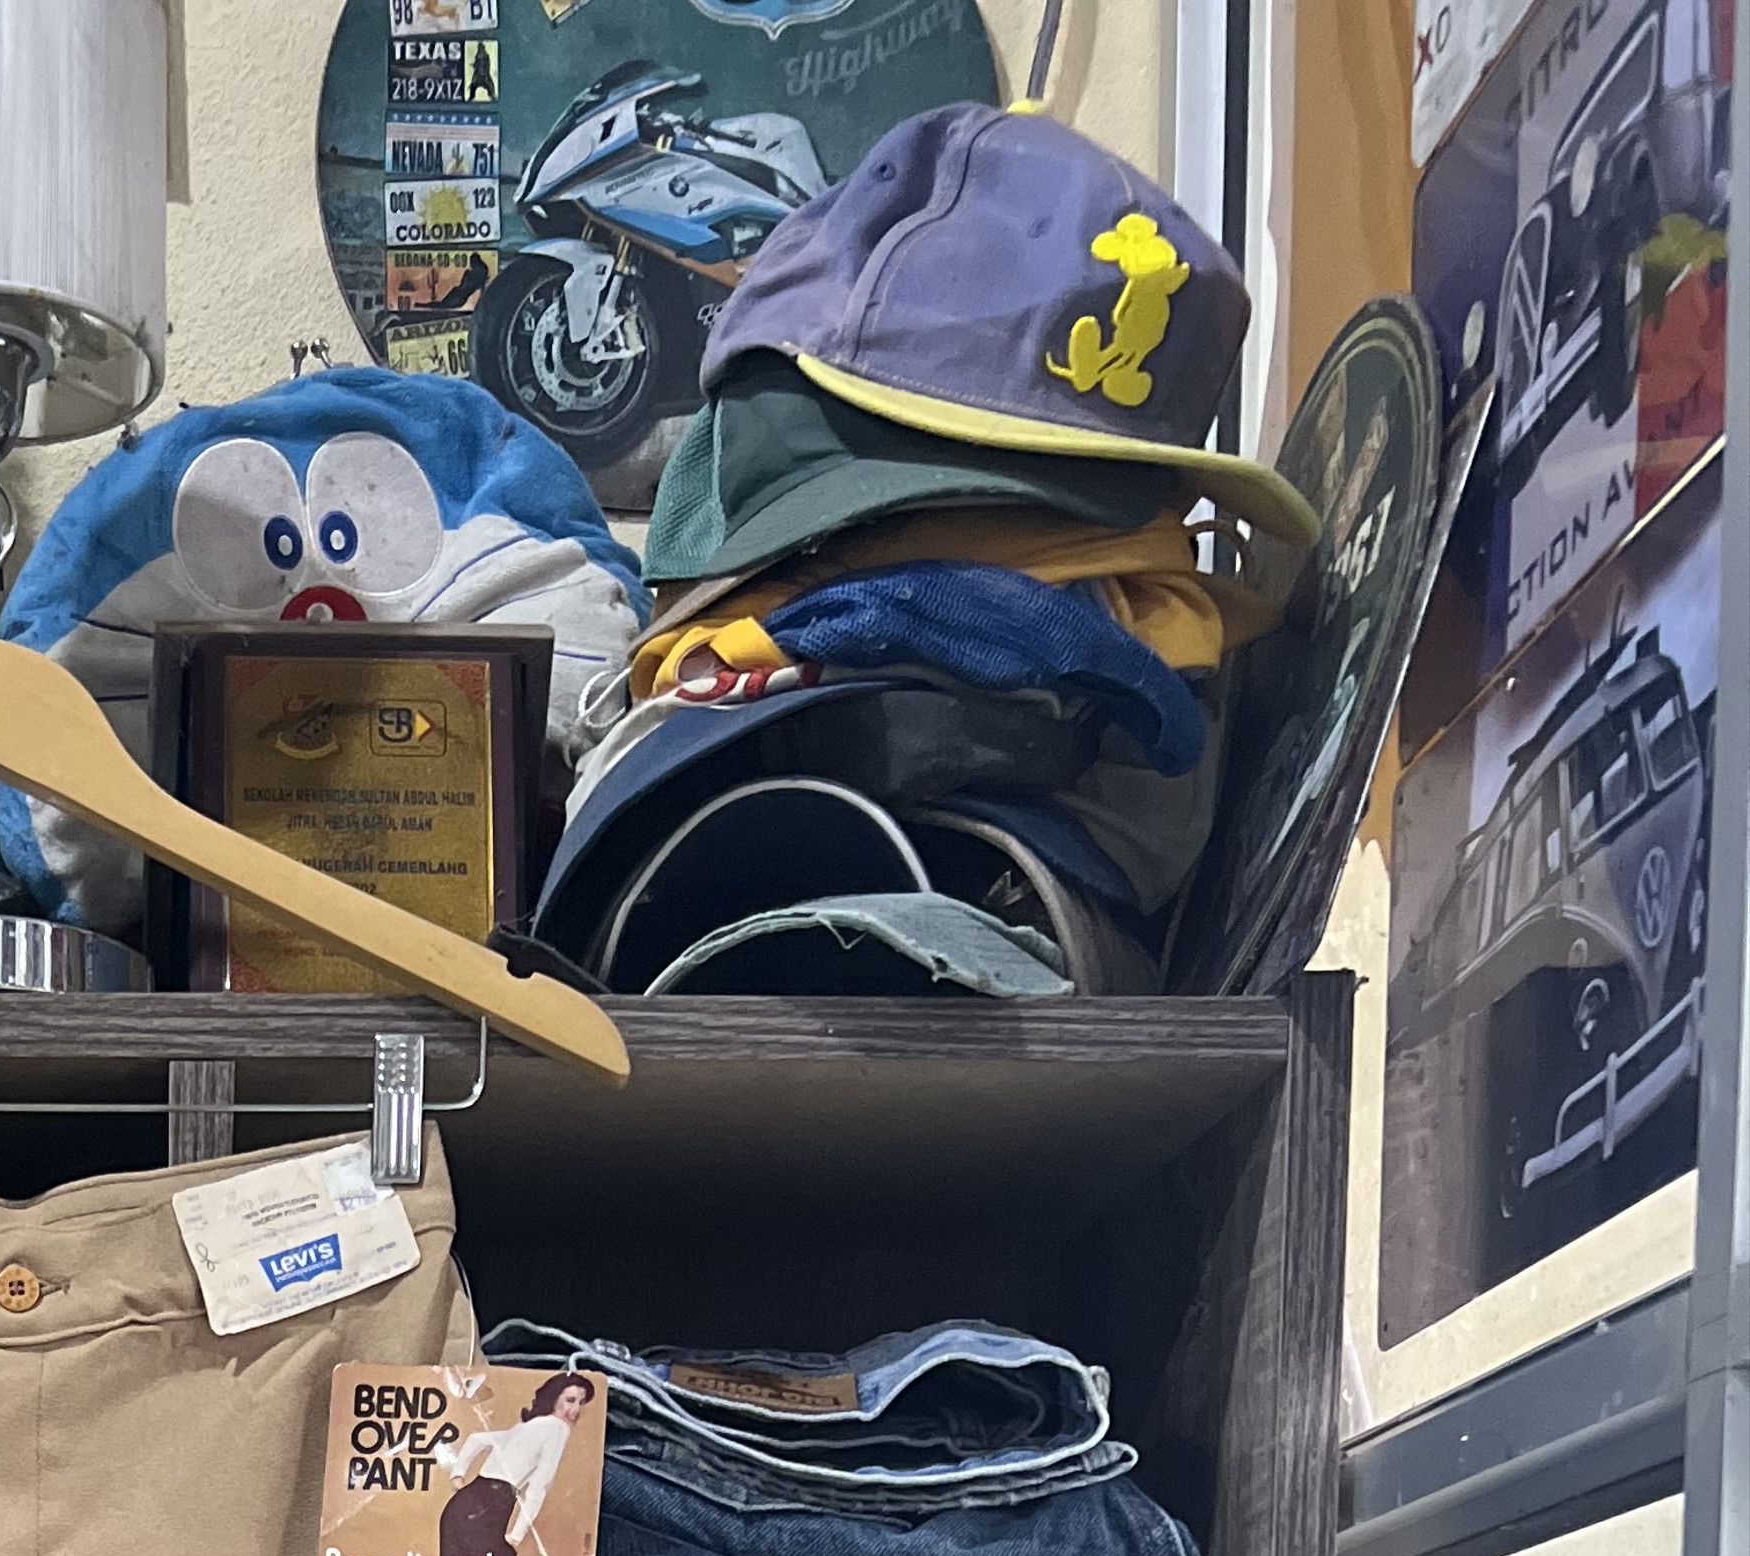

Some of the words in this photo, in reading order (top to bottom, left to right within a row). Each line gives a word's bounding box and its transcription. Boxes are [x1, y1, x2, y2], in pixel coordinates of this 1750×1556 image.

[393, 41, 462, 61] TEXAS
[391, 140, 444, 174] NEVADA
[472, 143, 495, 175] 751
[472, 187, 496, 209] 123
[395, 221, 492, 242] COLORADO
[377, 860, 469, 876] CEMERLANG
[353, 1384, 448, 1419] BEND
[351, 1420, 460, 1455] OVER
[347, 1457, 437, 1491] PANT
